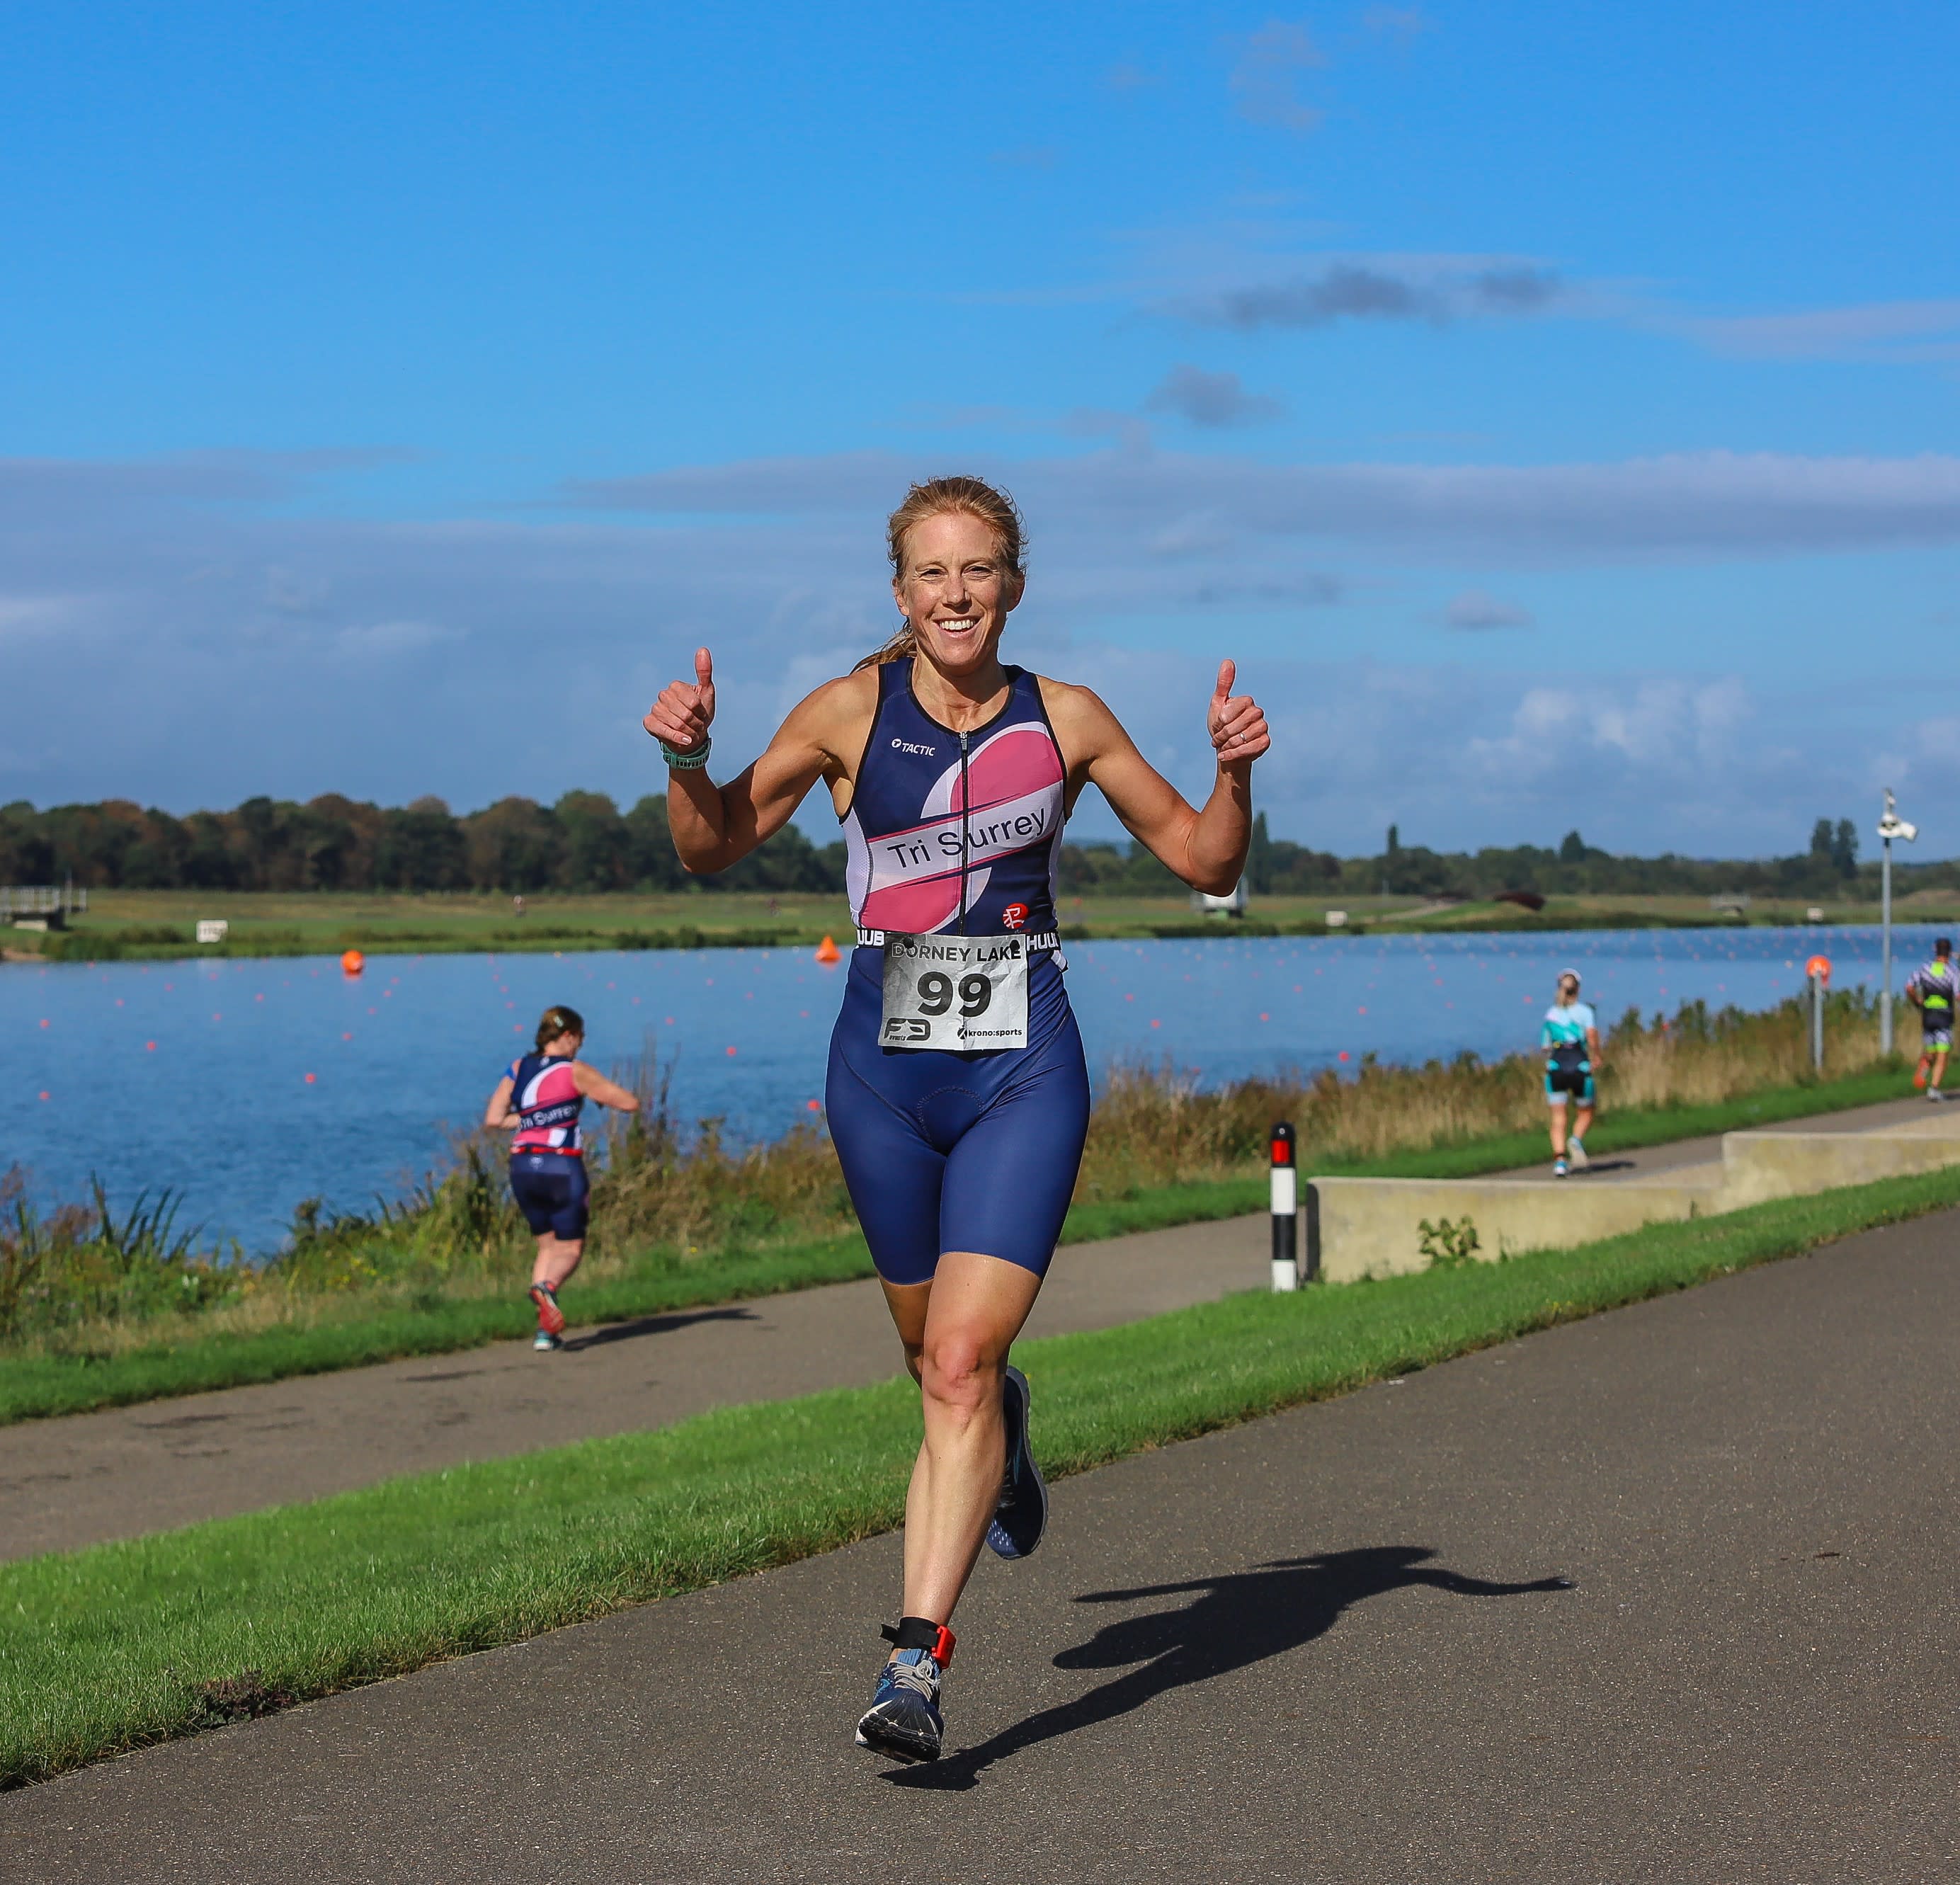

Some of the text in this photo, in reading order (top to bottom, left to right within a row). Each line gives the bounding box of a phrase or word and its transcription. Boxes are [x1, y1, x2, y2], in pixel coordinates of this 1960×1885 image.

[902, 743, 935, 756] TACTIC
[887, 808, 1044, 868] Tri Surrey
[1026, 933, 1059, 951] HUU
[892, 942, 1021, 962] DORNEY LAKE
[918, 972, 991, 1018] 99
[969, 1028, 1022, 1037] krono:sports
